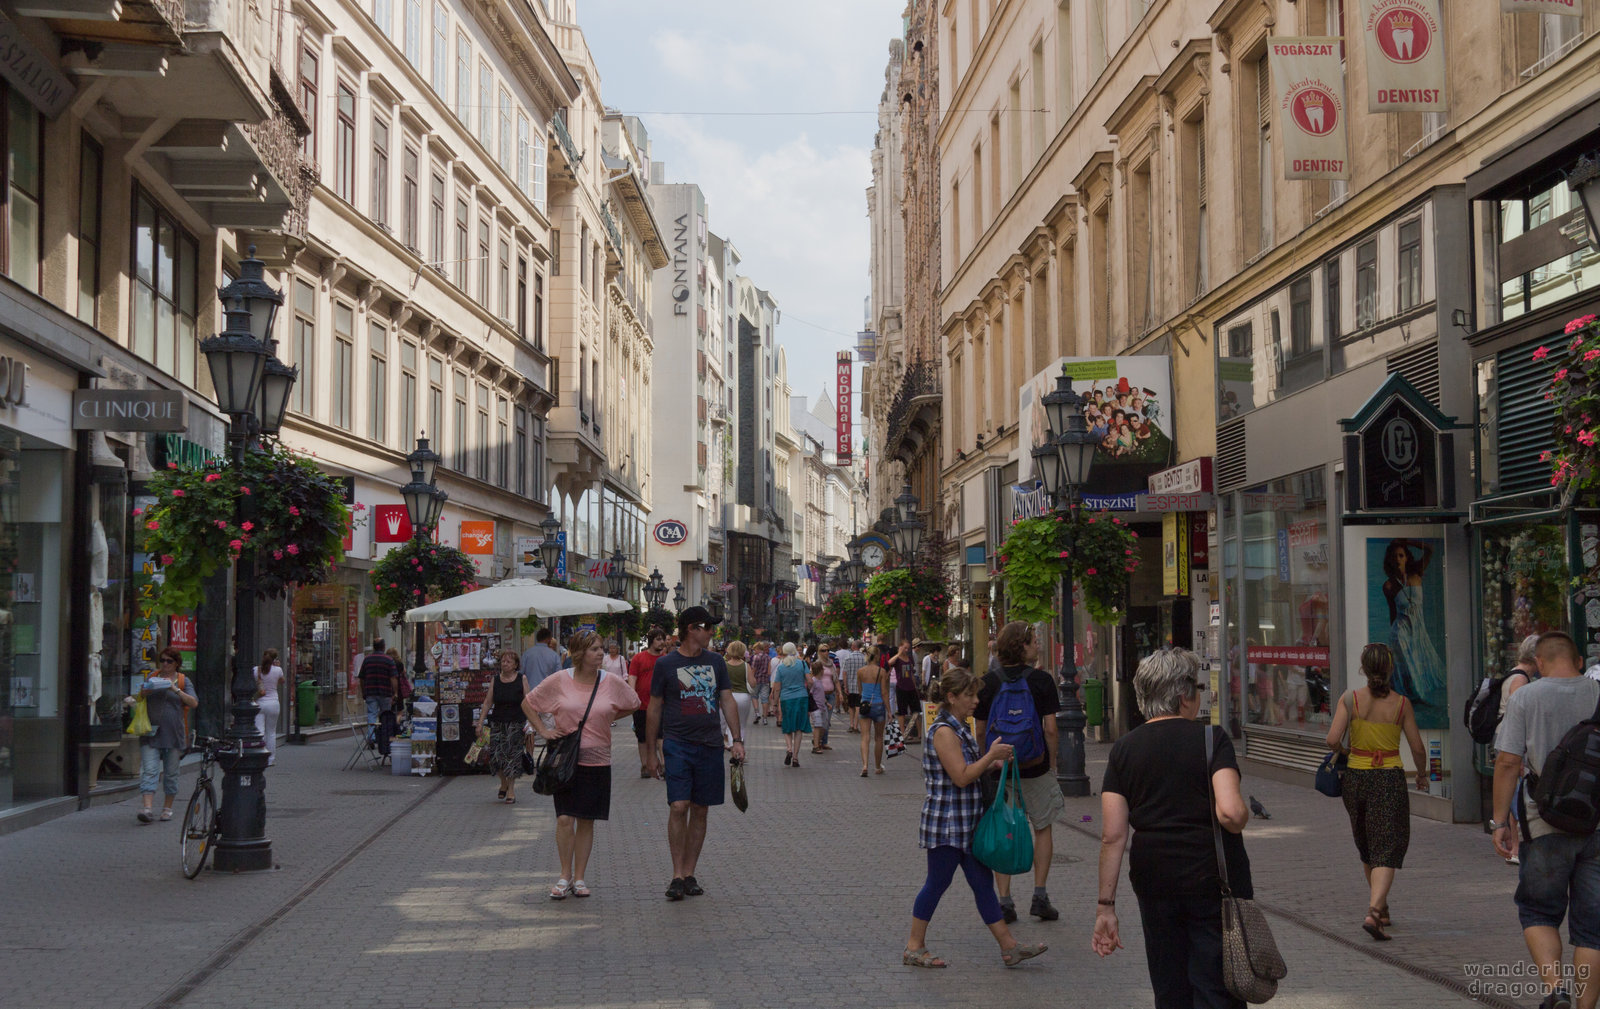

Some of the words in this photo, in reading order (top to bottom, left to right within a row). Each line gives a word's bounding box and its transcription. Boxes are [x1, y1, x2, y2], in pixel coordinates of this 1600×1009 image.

[1274, 41, 1333, 56] FOGÁSZAT
[1377, 89, 1440, 103] DENTIST
[1293, 160, 1344, 173] DENTIST
[672, 213, 689, 317] FONTANA
[79, 400, 178, 421] CLINIQUE
[838, 365, 850, 453] McDonald's
[1164, 469, 1182, 489] DENTIST
[1147, 494, 1201, 510] ESPRIT
[659, 526, 682, 539] C&A
[172, 620, 188, 642] SALE
